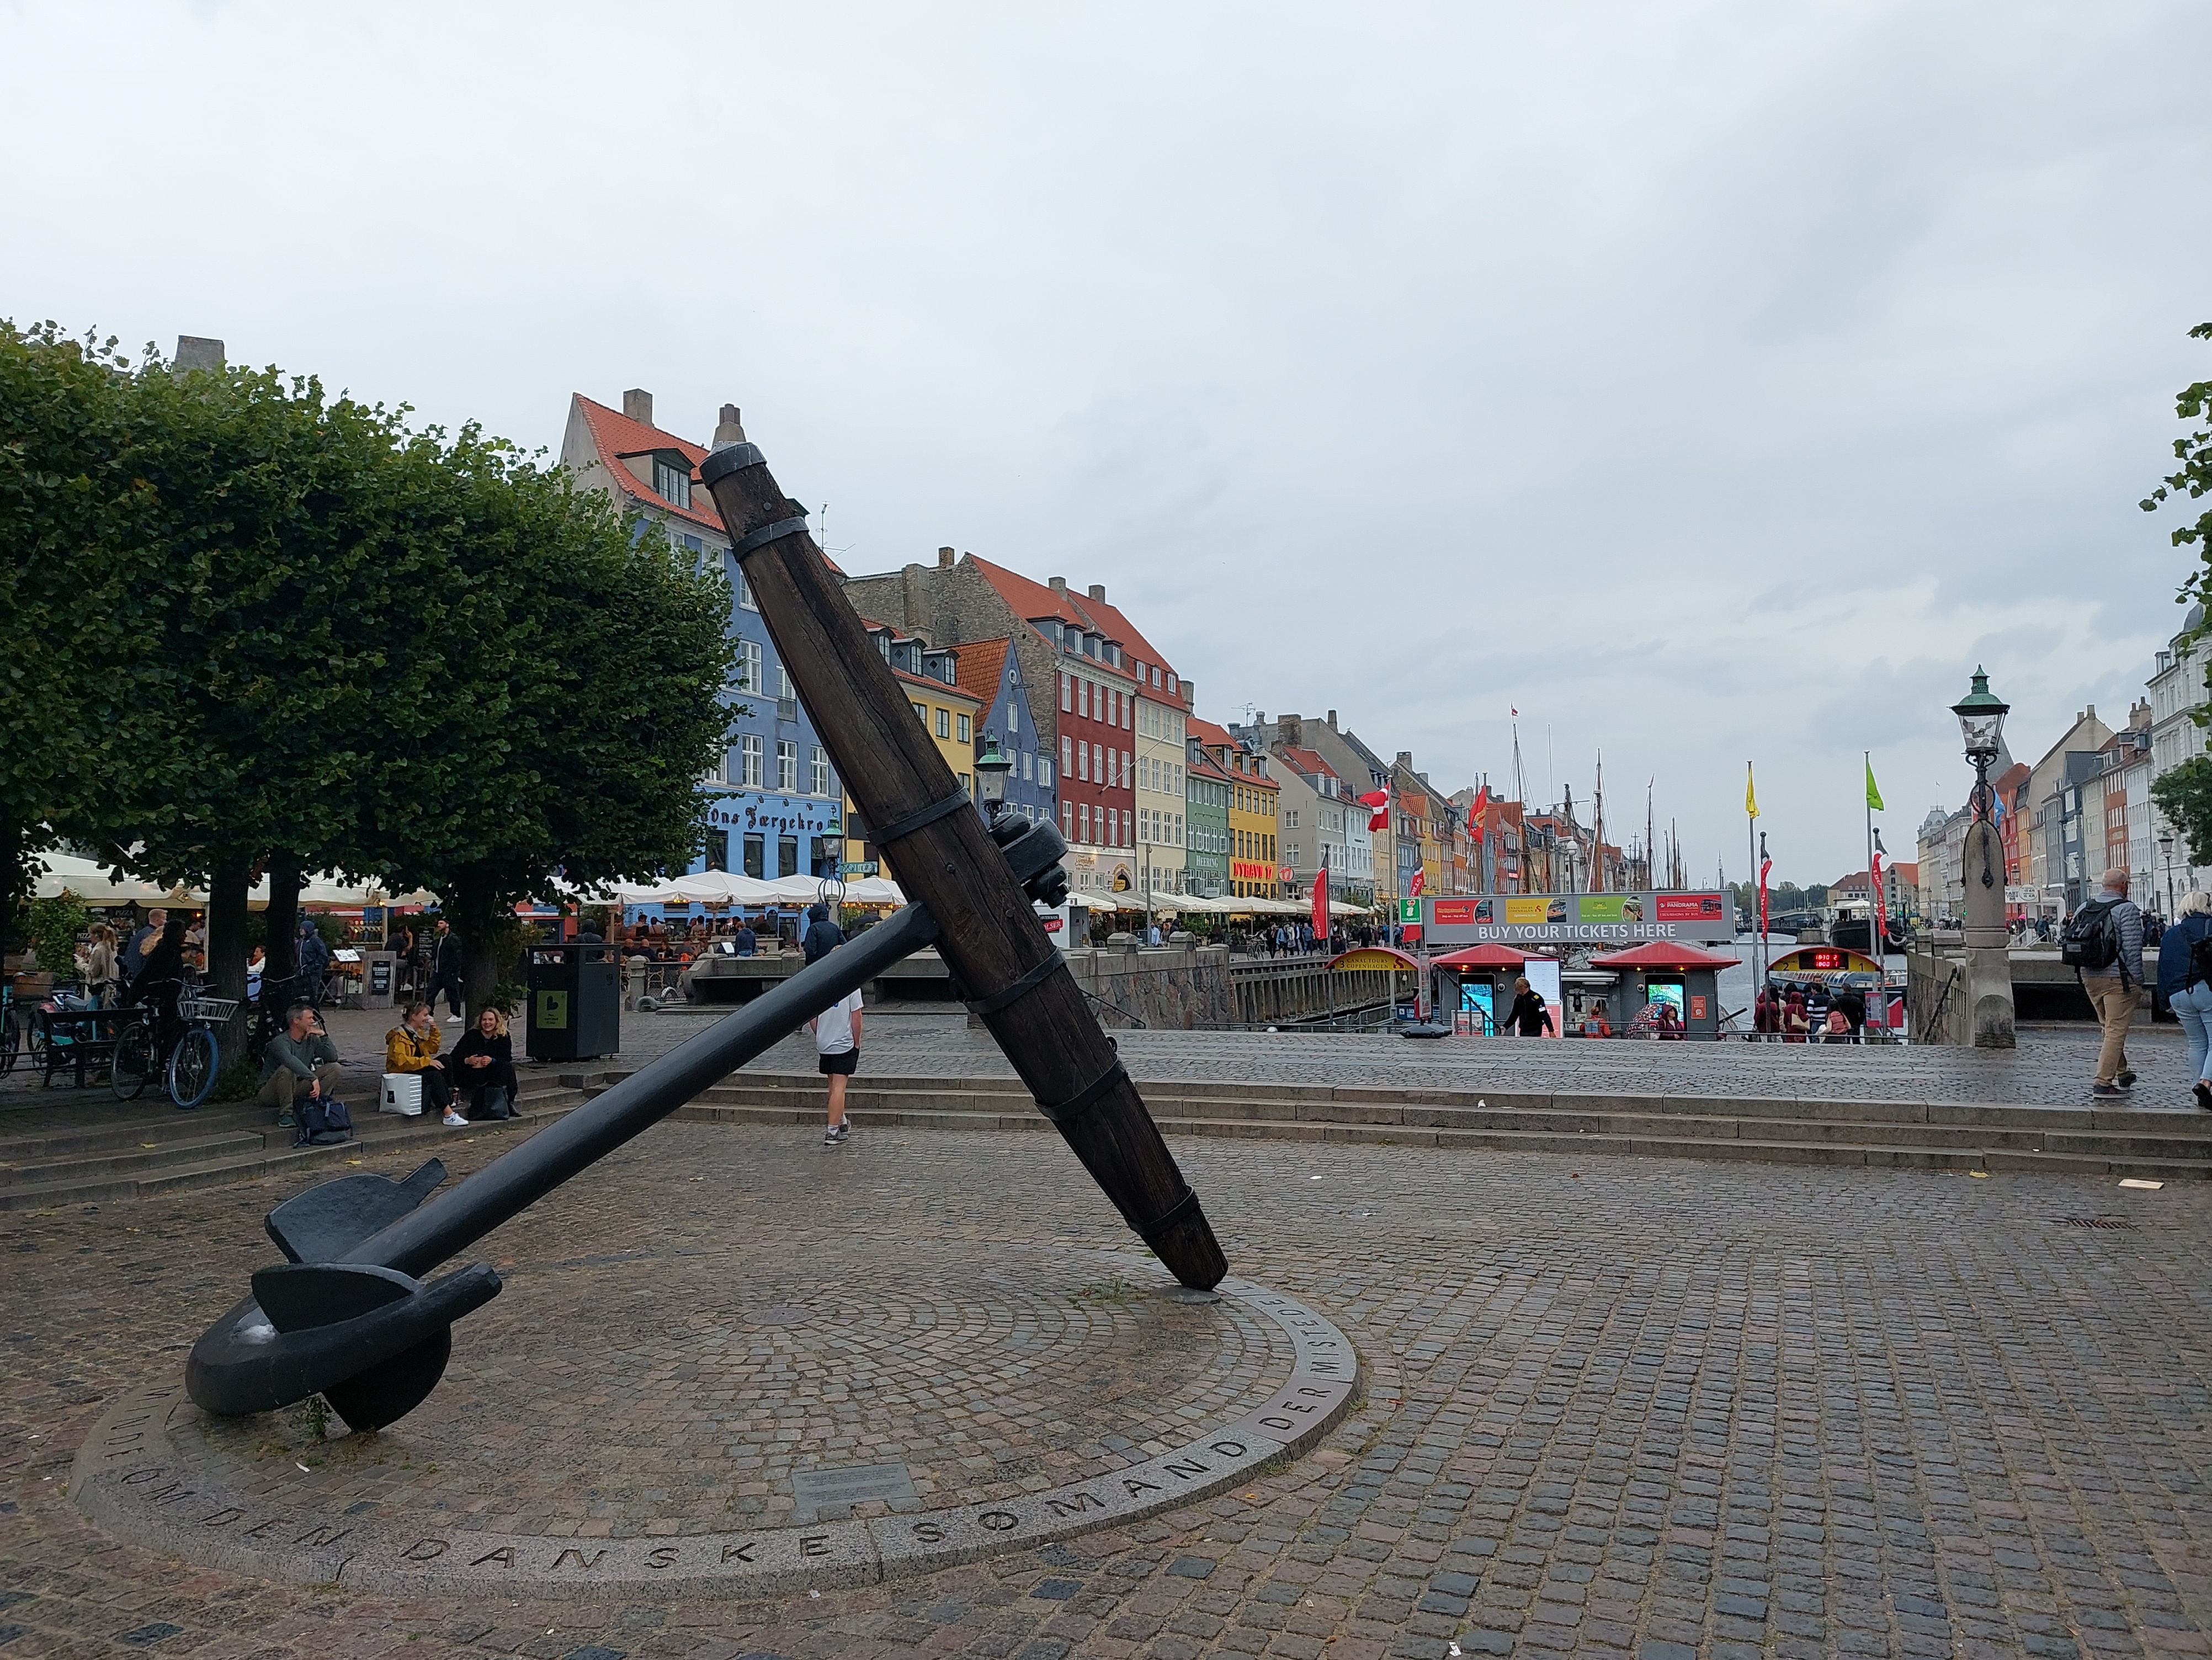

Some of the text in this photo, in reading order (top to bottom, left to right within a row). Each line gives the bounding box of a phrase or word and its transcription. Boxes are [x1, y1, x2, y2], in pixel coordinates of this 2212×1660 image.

[746, 805, 823, 833] Færgekro
[1196, 855, 1219, 868] HEERING
[1233, 862, 1273, 879] NYHAVN 17
[1279, 868, 1291, 880] 17
[1479, 924, 1677, 939] BUY YOUR TICKETS HERE
[1859, 962, 1864, 971] 1
[1258, 1299, 1341, 1374] MISTEDE
[1258, 1388, 1332, 1430] DER
[120, 1468, 196, 1507] OM
[912, 1441, 1248, 1544] SØMAND
[197, 1507, 356, 1546] DEN
[398, 1534, 833, 1569] DANSKE
